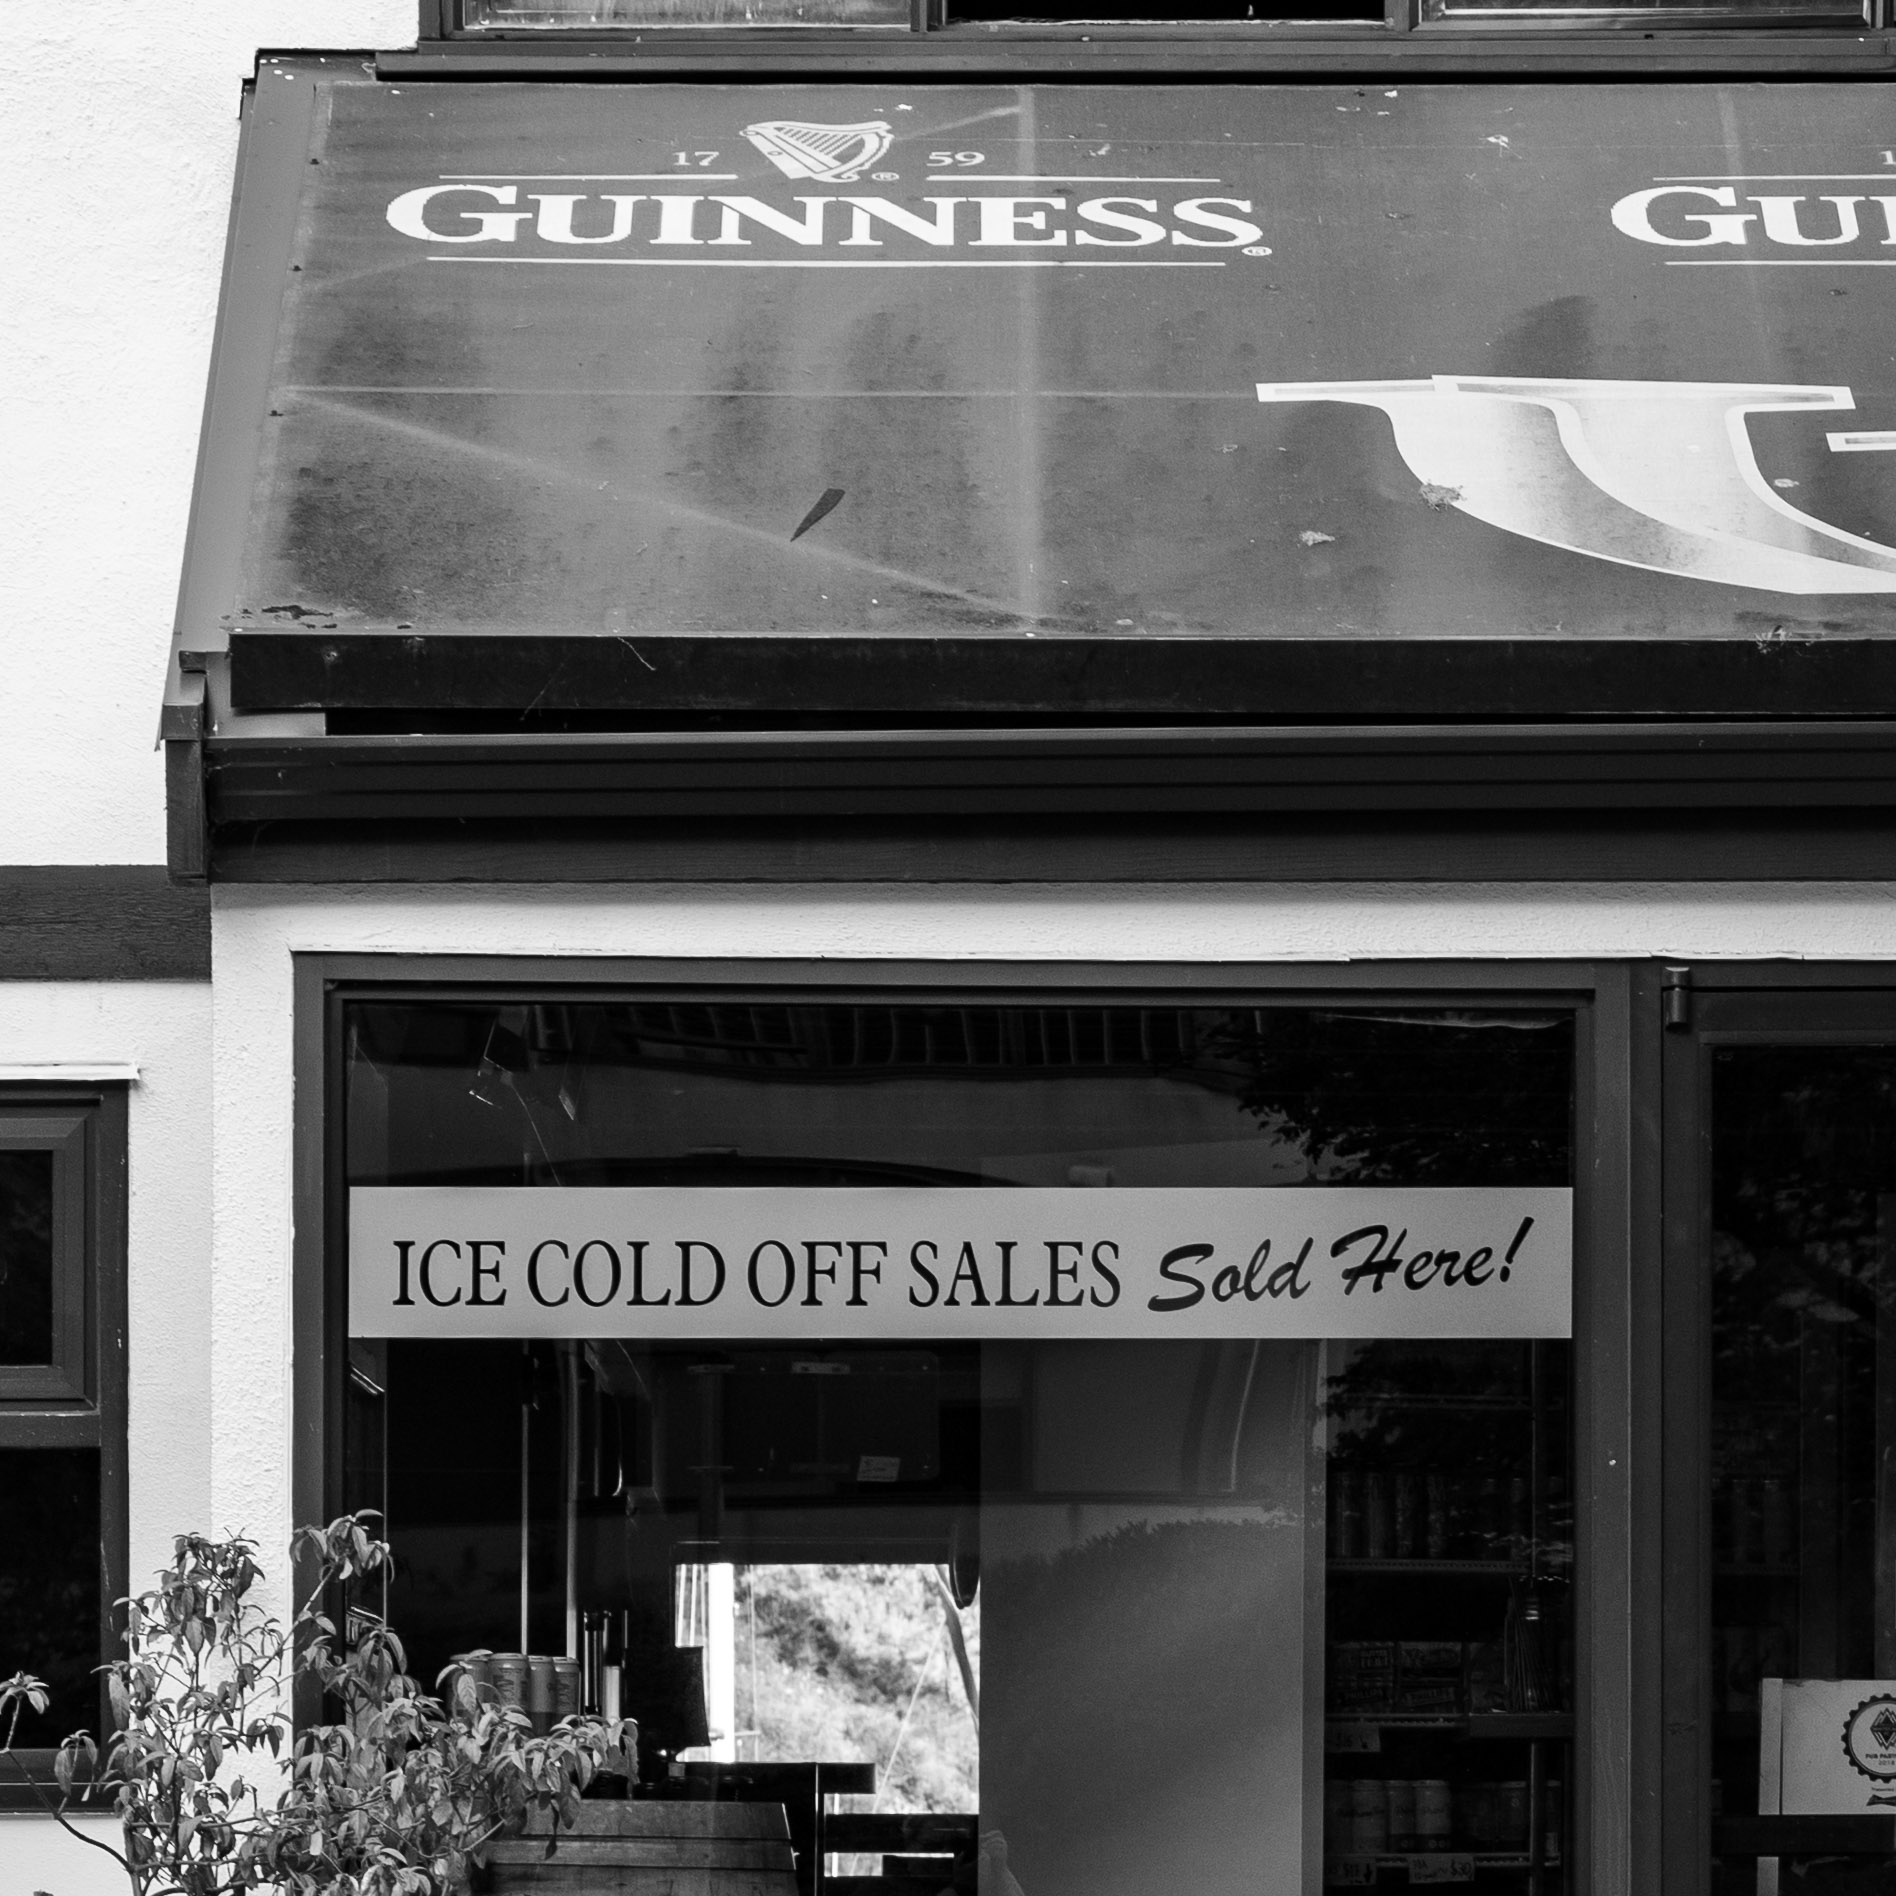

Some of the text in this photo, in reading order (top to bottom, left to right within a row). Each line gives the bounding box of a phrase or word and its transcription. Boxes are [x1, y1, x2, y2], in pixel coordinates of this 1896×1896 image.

[673, 150, 986, 168] 17 59
[385, 184, 1264, 248] GUINNESS
[391, 1215, 1536, 1314] ICE COLD OFF SALES Sold Here!
